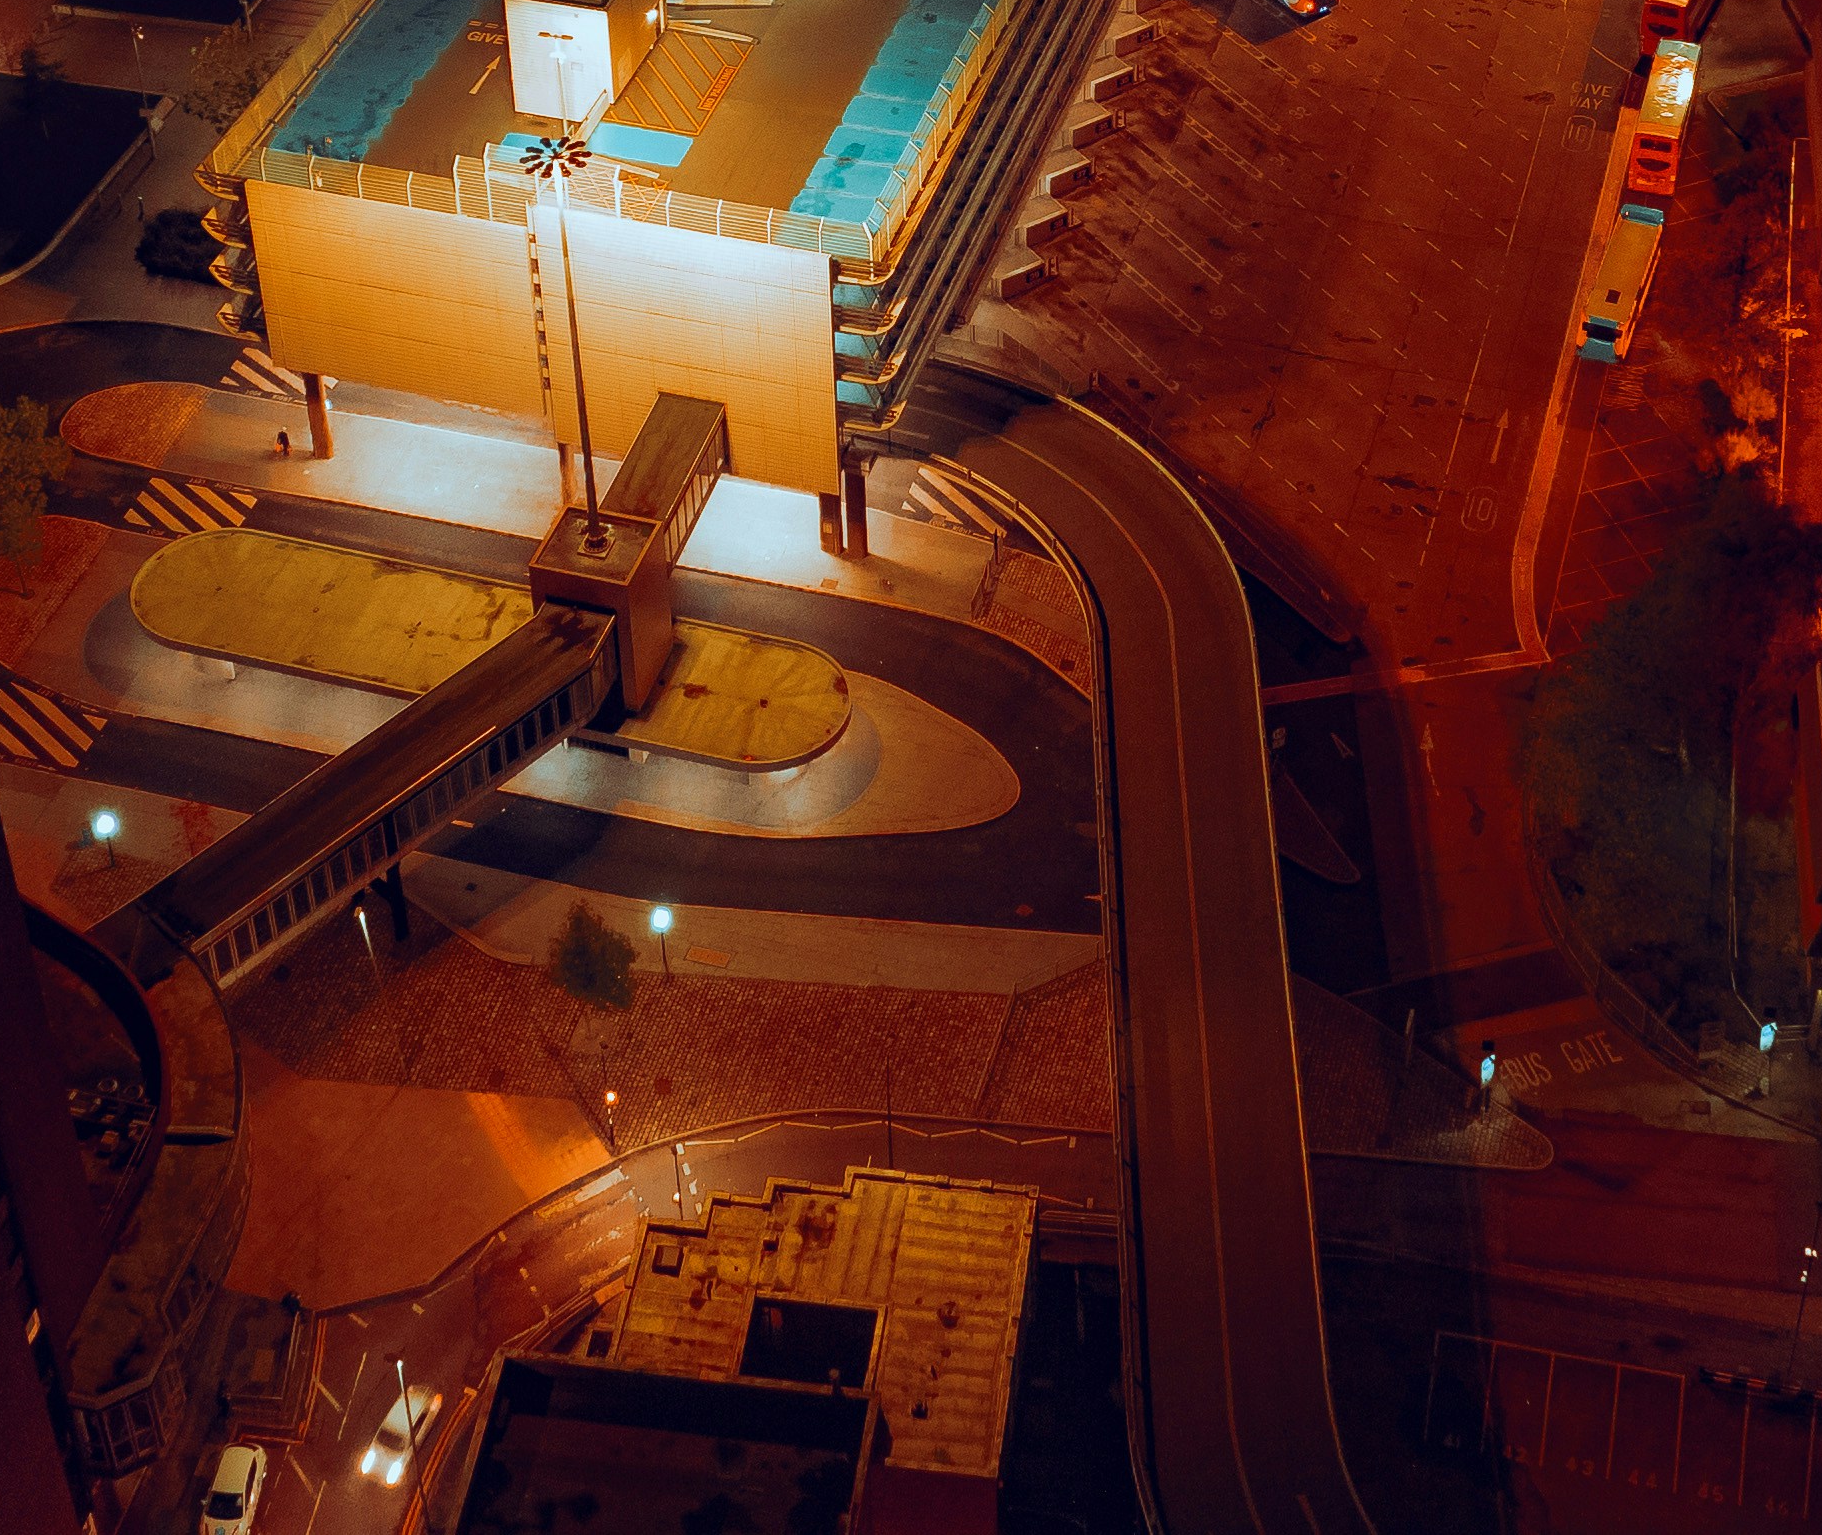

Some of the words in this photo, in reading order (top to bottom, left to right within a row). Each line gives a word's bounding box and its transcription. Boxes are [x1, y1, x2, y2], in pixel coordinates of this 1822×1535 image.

[466, 30, 506, 45] GIVE
[713, 67, 736, 98] PARKING
[1572, 81, 1613, 98] GIVE
[1570, 97, 1603, 110] WAY
[1468, 496, 1493, 521] 10
[1500, 1052, 1554, 1091] BUS
[1560, 1030, 1624, 1074] GATE
